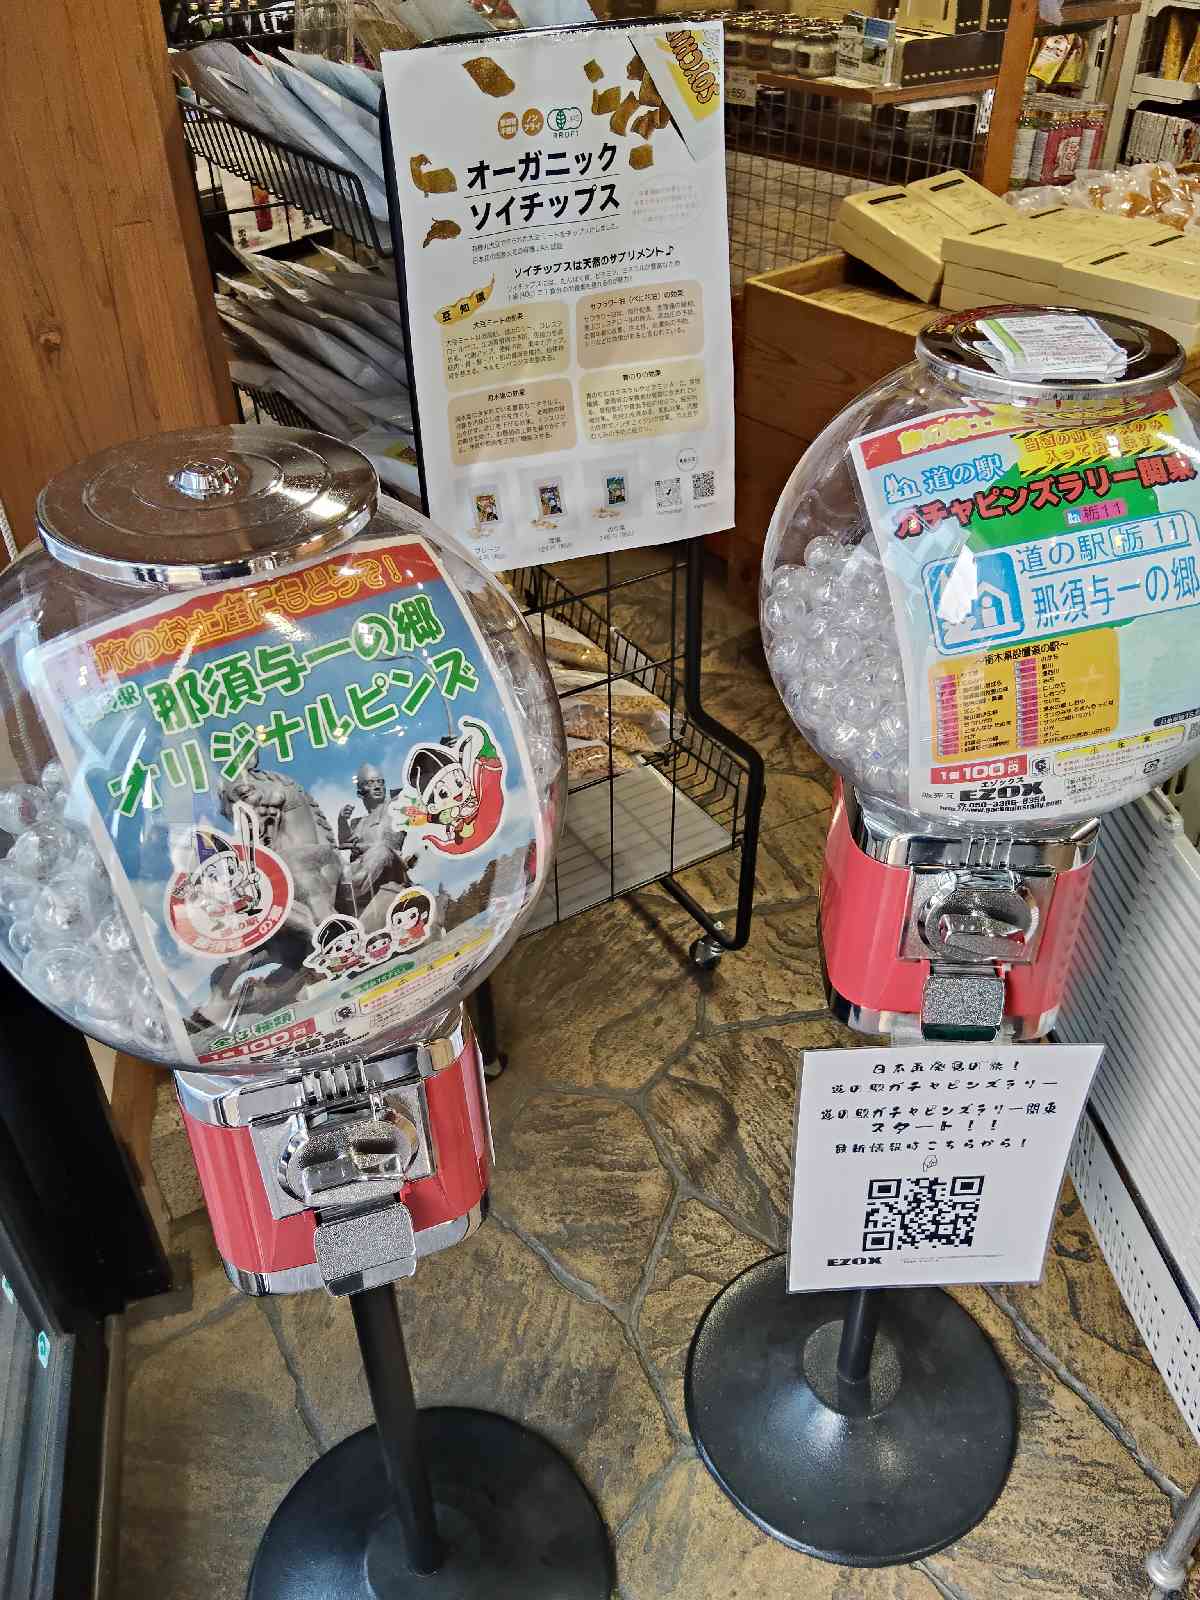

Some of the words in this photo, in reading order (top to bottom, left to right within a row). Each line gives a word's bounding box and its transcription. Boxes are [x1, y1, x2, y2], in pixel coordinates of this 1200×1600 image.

[467, 143, 617, 190] オーガニック
[471, 183, 620, 231] ソイチップス
[895, 452, 1198, 539] ガチャピンズラリー関東
[926, 453, 1004, 494] 道の駅
[1016, 533, 1109, 574] 道の駅
[1031, 555, 1200, 629] 那須与一の郷
[144, 593, 445, 737] 那須与一の郷
[107, 647, 480, 818] オリジナルピンズ
[960, 782, 1044, 801] EZOX
[831, 1079, 1058, 1094] 道の駅ガチャピンズラリー
[826, 1255, 883, 1267] EZOX
